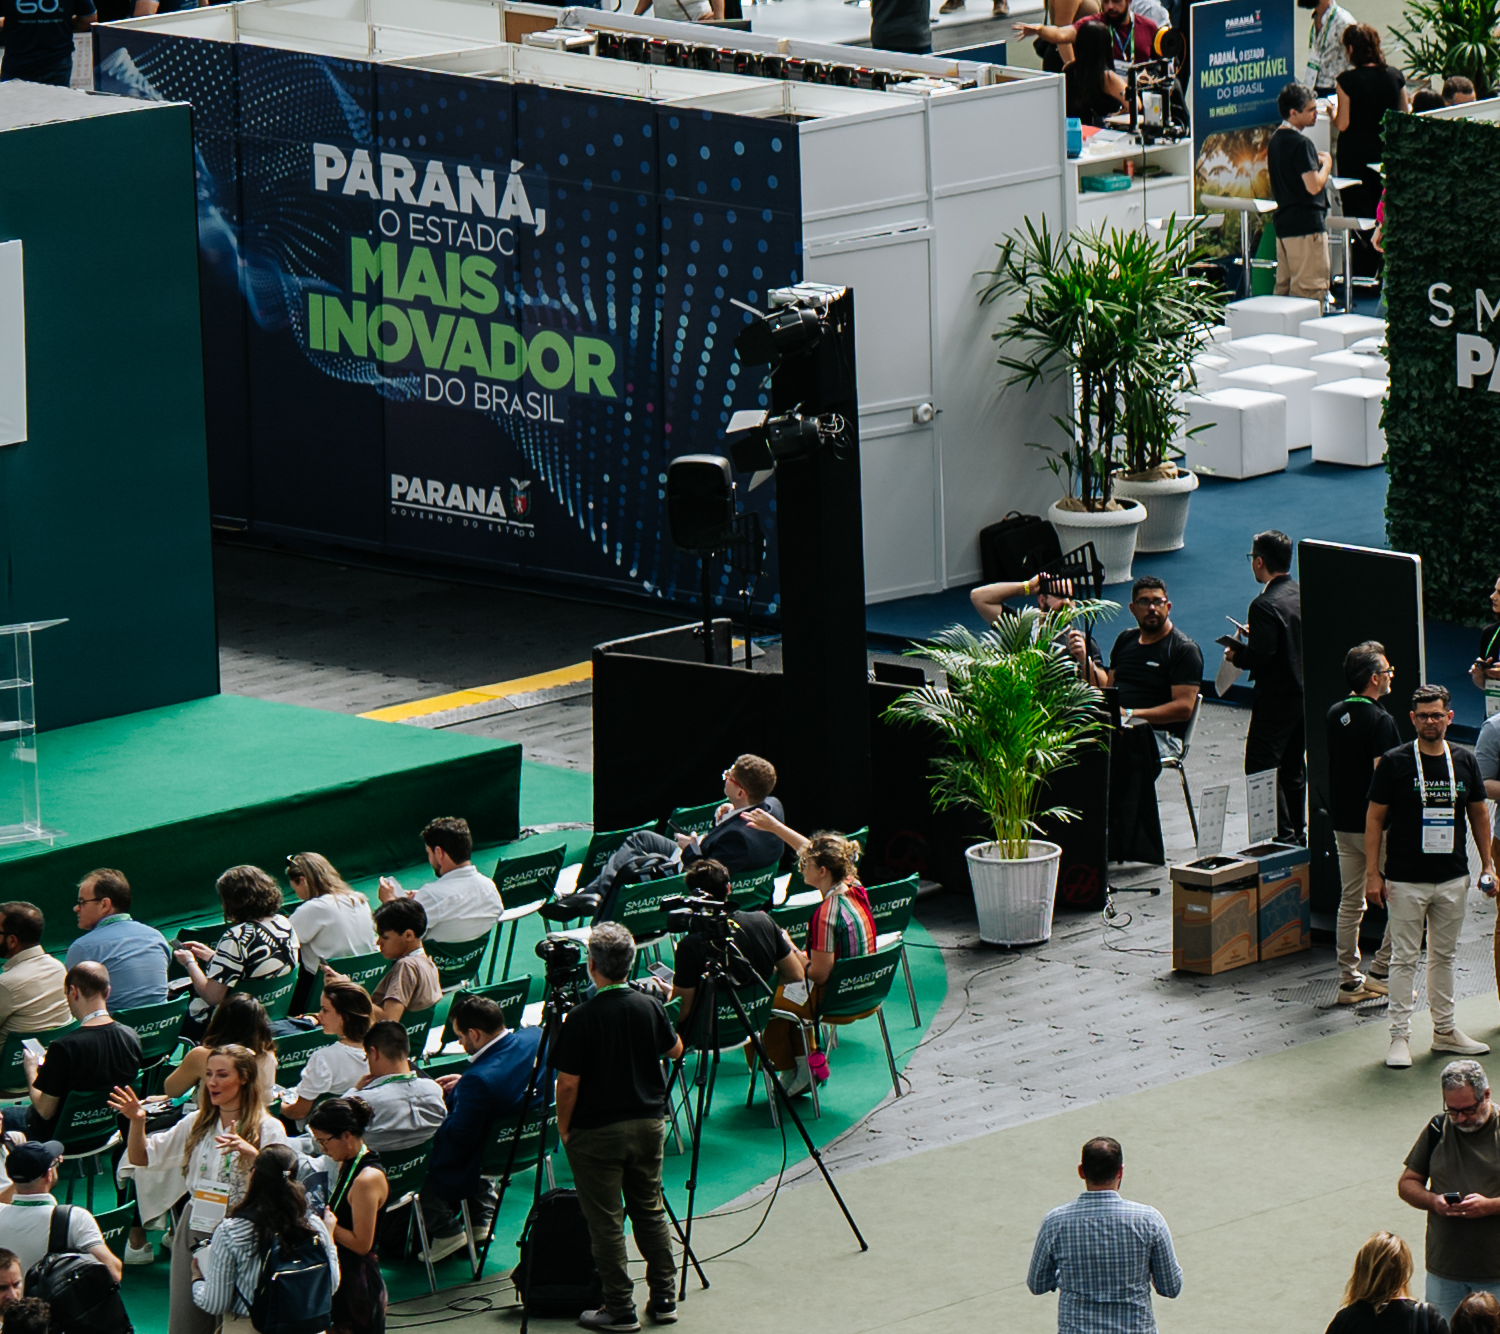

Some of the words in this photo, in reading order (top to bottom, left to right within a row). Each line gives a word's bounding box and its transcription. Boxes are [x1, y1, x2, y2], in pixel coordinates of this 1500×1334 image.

[1201, 67, 1224, 88] MAIS
[1226, 55, 1288, 84] SUSTENTÁVEL
[1217, 87, 1231, 100] DO
[1233, 82, 1264, 97] BRASIL
[313, 142, 546, 236] PARANÁ,
[379, 209, 400, 237] O
[351, 236, 499, 314] MAIS
[308, 293, 618, 398] INOVADOR
[425, 374, 466, 405] DO
[474, 382, 564, 424] BRASIL
[391, 473, 507, 518] PARANÁ
[391, 508, 453, 525] GOVERNO
[463, 519, 478, 529] DO
[488, 523, 535, 538] ESTADO
